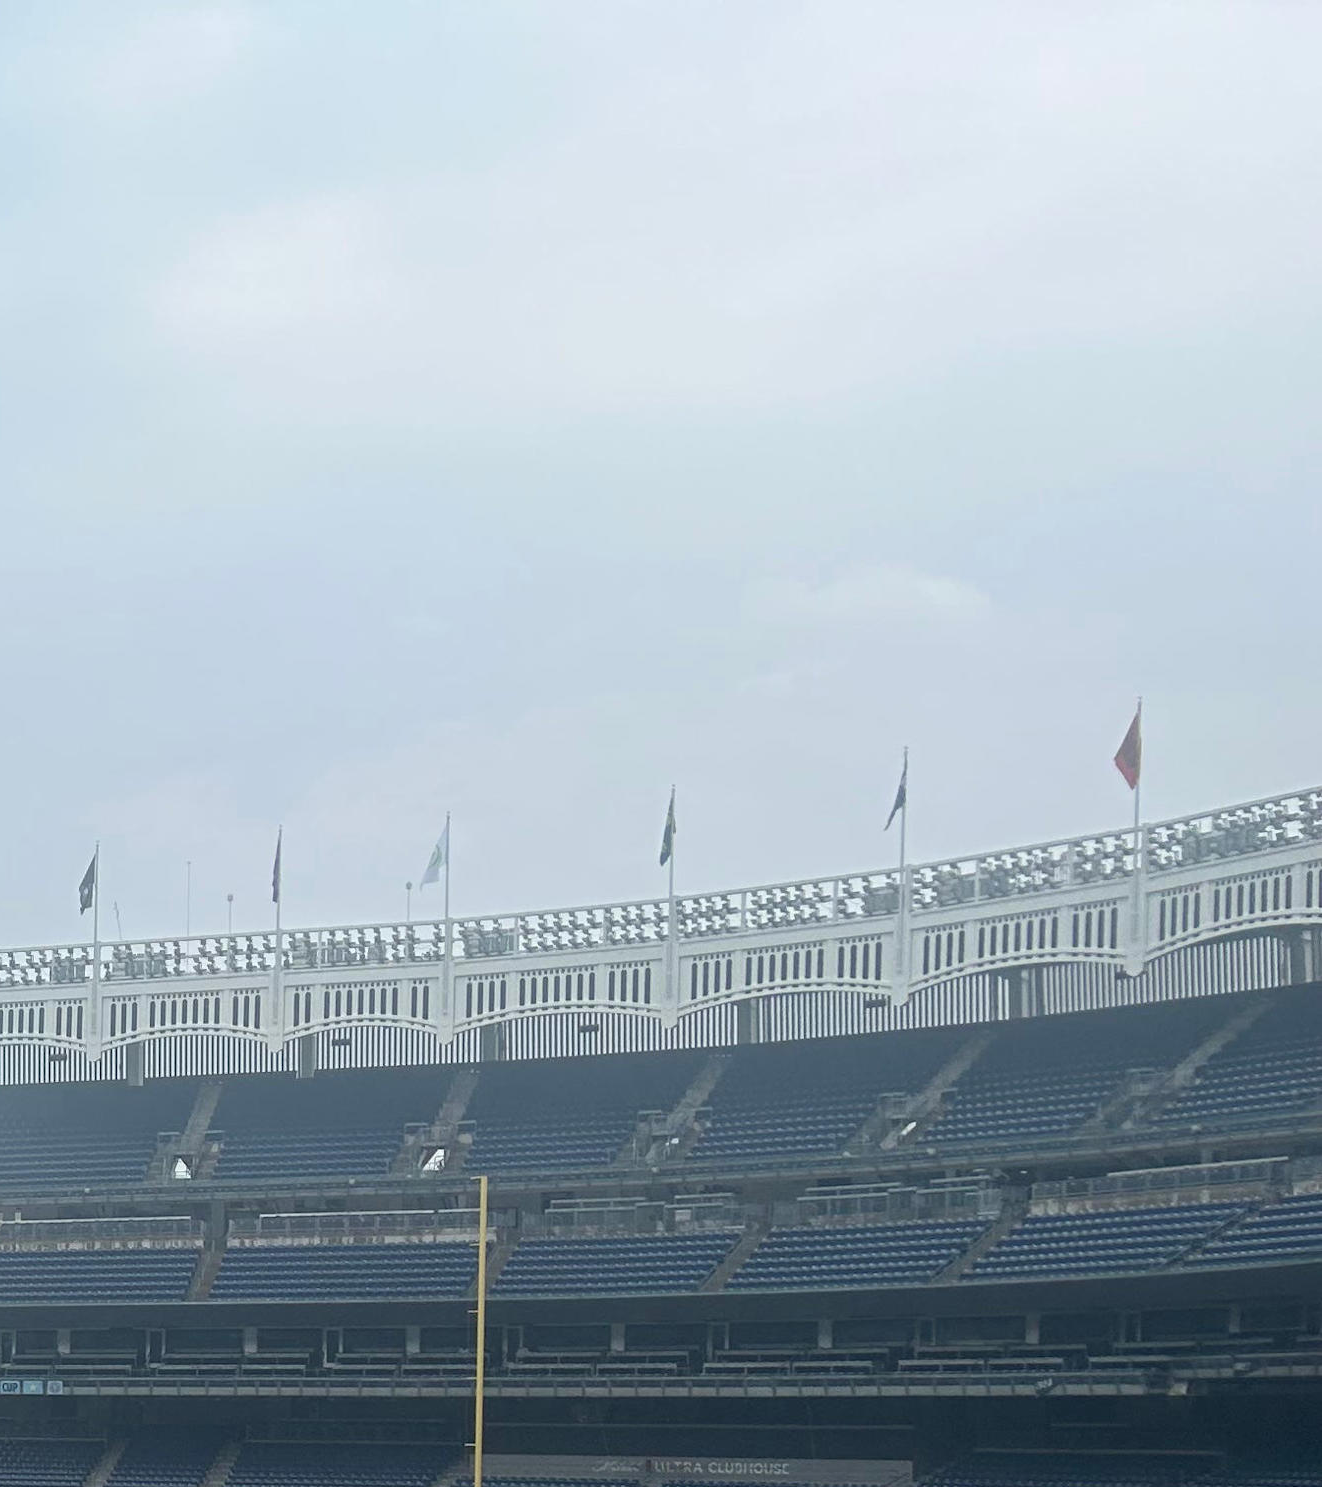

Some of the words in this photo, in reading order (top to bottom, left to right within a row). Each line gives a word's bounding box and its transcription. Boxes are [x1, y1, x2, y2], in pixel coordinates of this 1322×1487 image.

[2, 1382, 18, 1392] CUP
[655, 1461, 703, 1473] ULTRA
[707, 1461, 789, 1475] CLUBHOUSE
